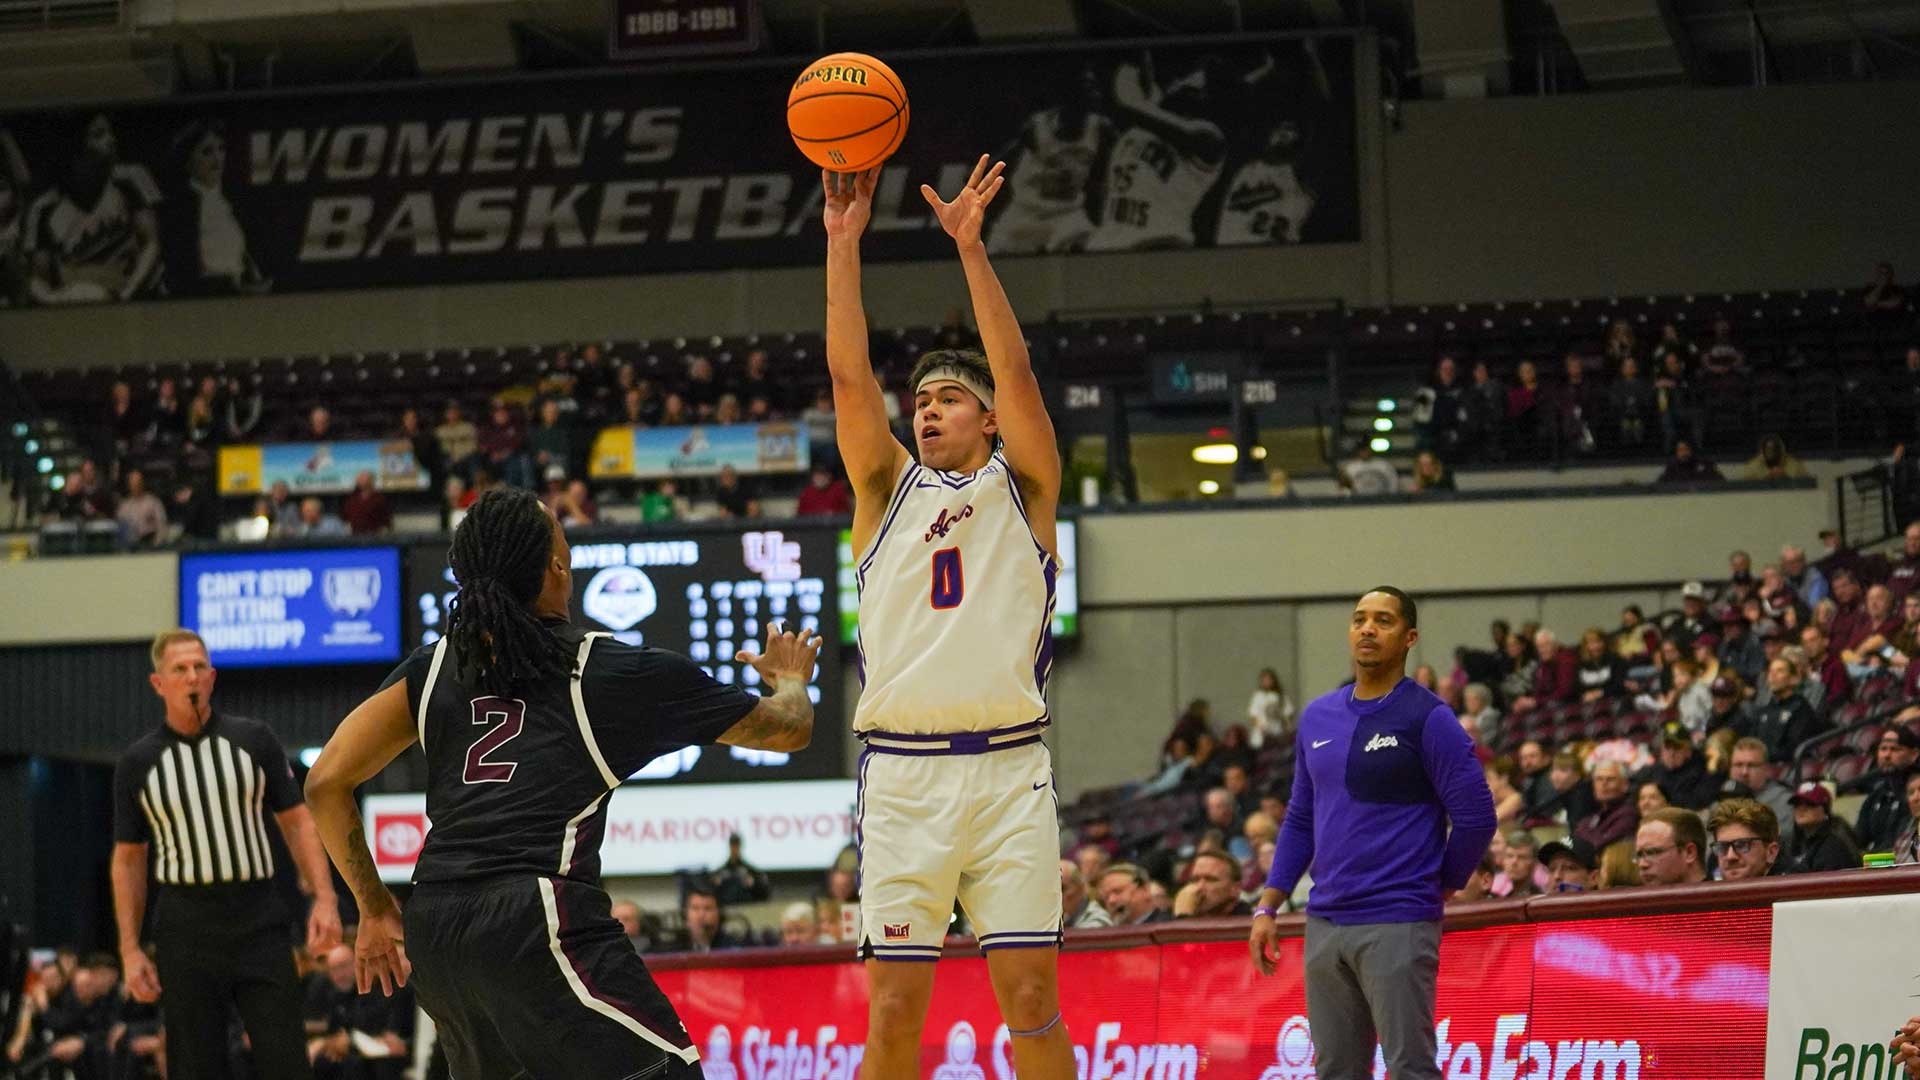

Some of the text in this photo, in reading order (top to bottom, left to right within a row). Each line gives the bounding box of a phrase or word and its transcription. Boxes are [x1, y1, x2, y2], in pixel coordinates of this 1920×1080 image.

[796, 66, 868, 90] Wilson
[249, 107, 685, 186] WOMEN'S
[930, 545, 965, 612] 0
[462, 695, 526, 785] 2
[1365, 733, 1398, 752] Aces
[609, 815, 740, 843] MARION
